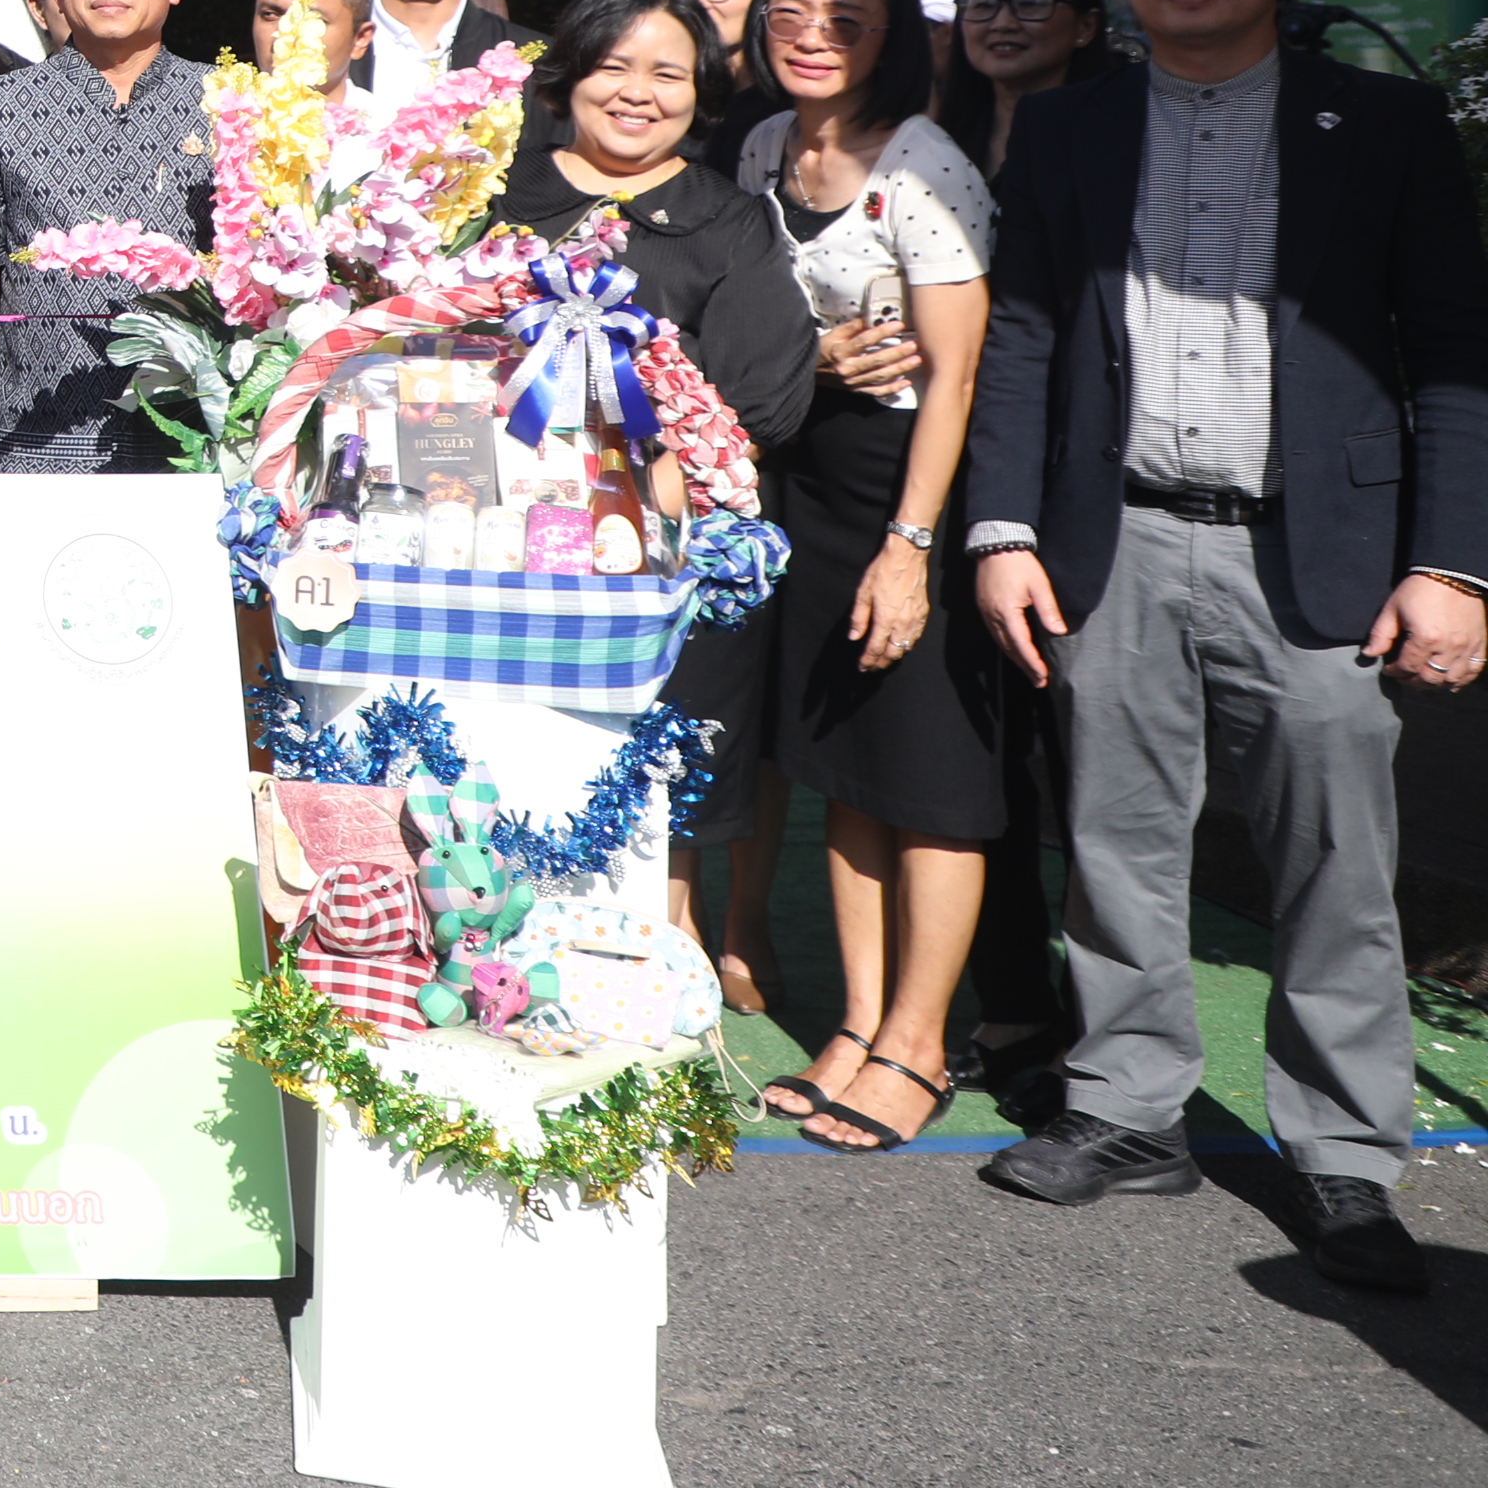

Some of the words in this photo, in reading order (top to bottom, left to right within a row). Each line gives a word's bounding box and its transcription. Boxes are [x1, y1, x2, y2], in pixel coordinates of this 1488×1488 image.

[415, 438, 476, 450] HUNGLEY
[294, 575, 335, 607] A1
[8, 1114, 38, 1137] น.
